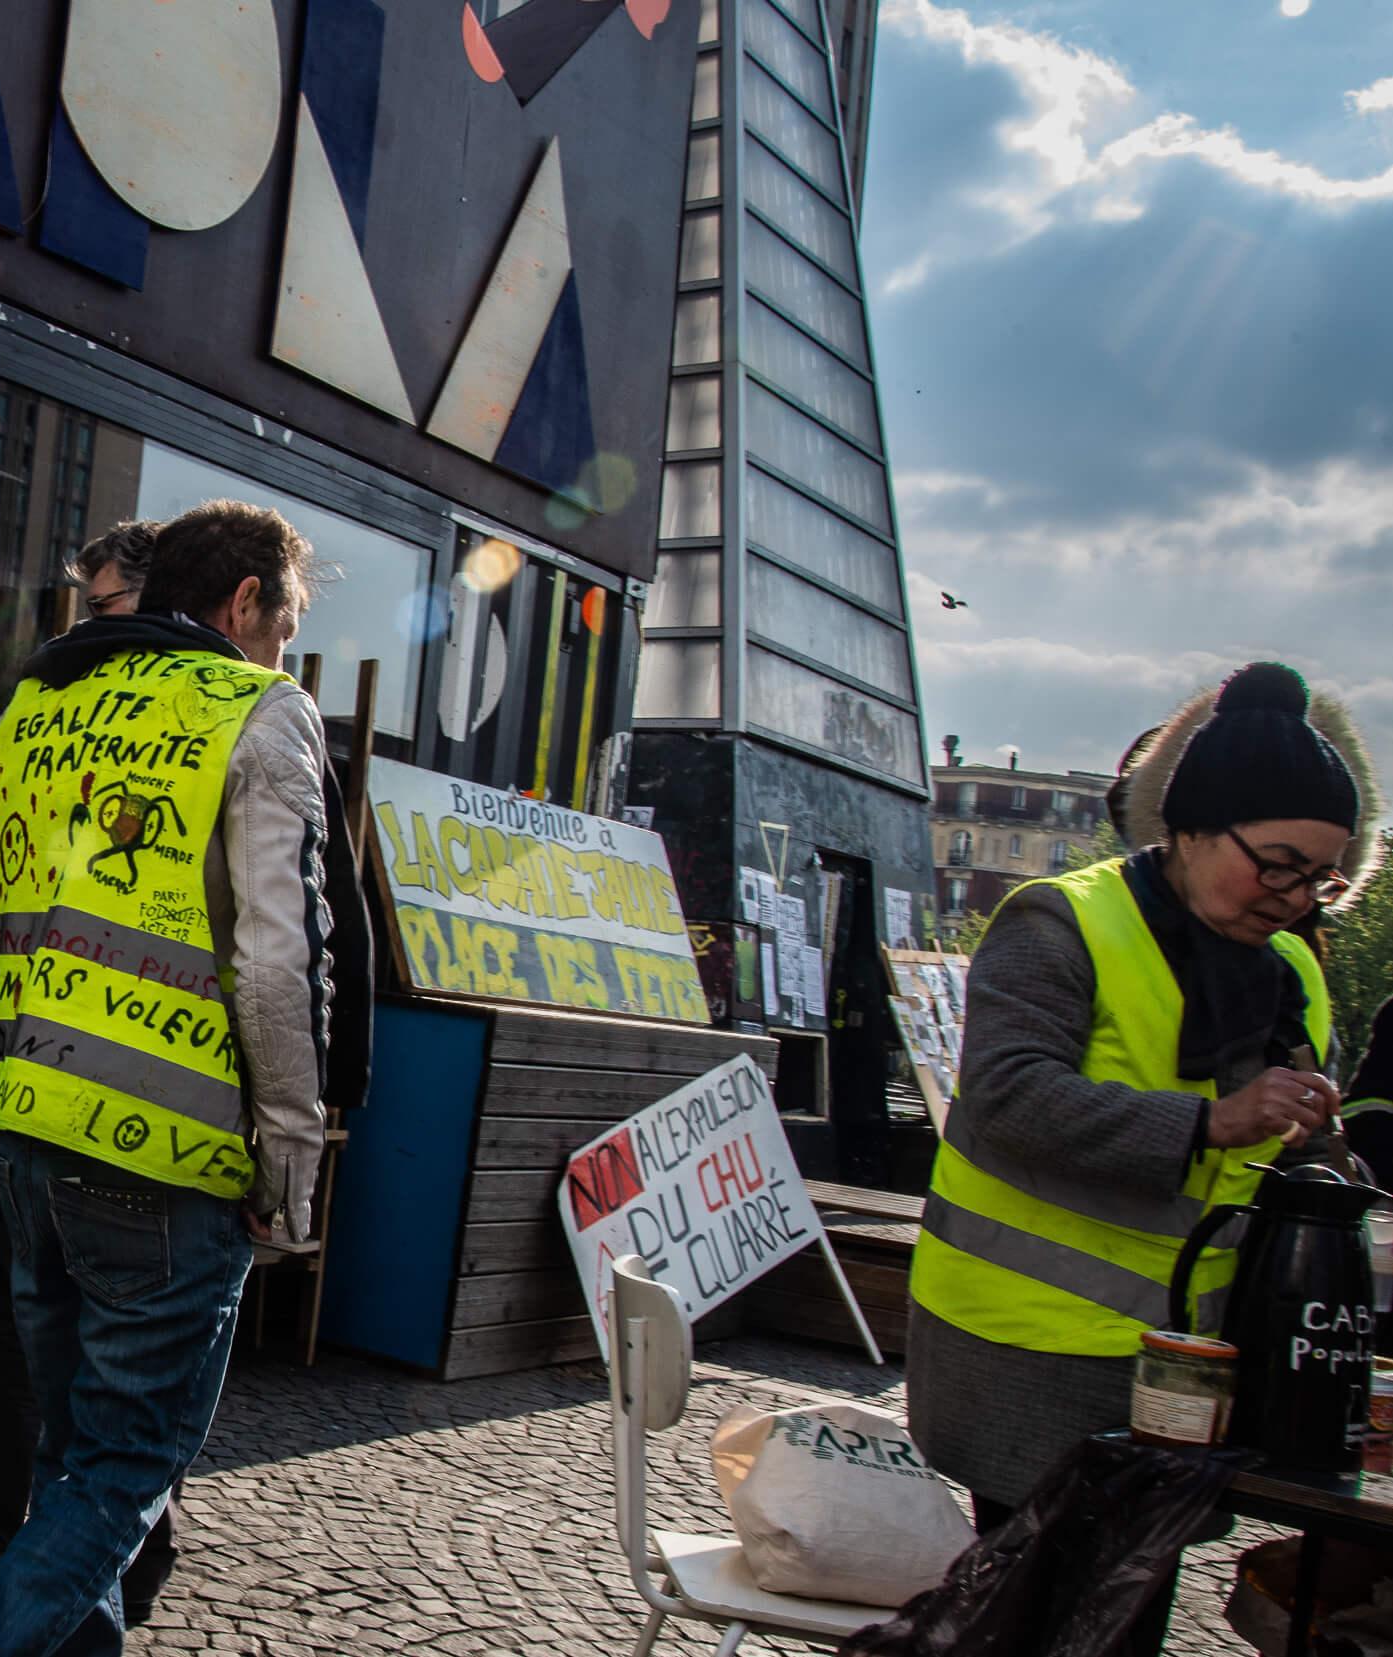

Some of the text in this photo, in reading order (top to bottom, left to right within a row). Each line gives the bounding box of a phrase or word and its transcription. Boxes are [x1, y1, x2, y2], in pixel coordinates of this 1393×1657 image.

[395, 904, 530, 1000] PLACE
[534, 931, 609, 1012] DES
[568, 1142, 645, 1233] NON
[626, 1132, 766, 1261] DU CHU
[686, 1166, 808, 1300] QUARRÉ
